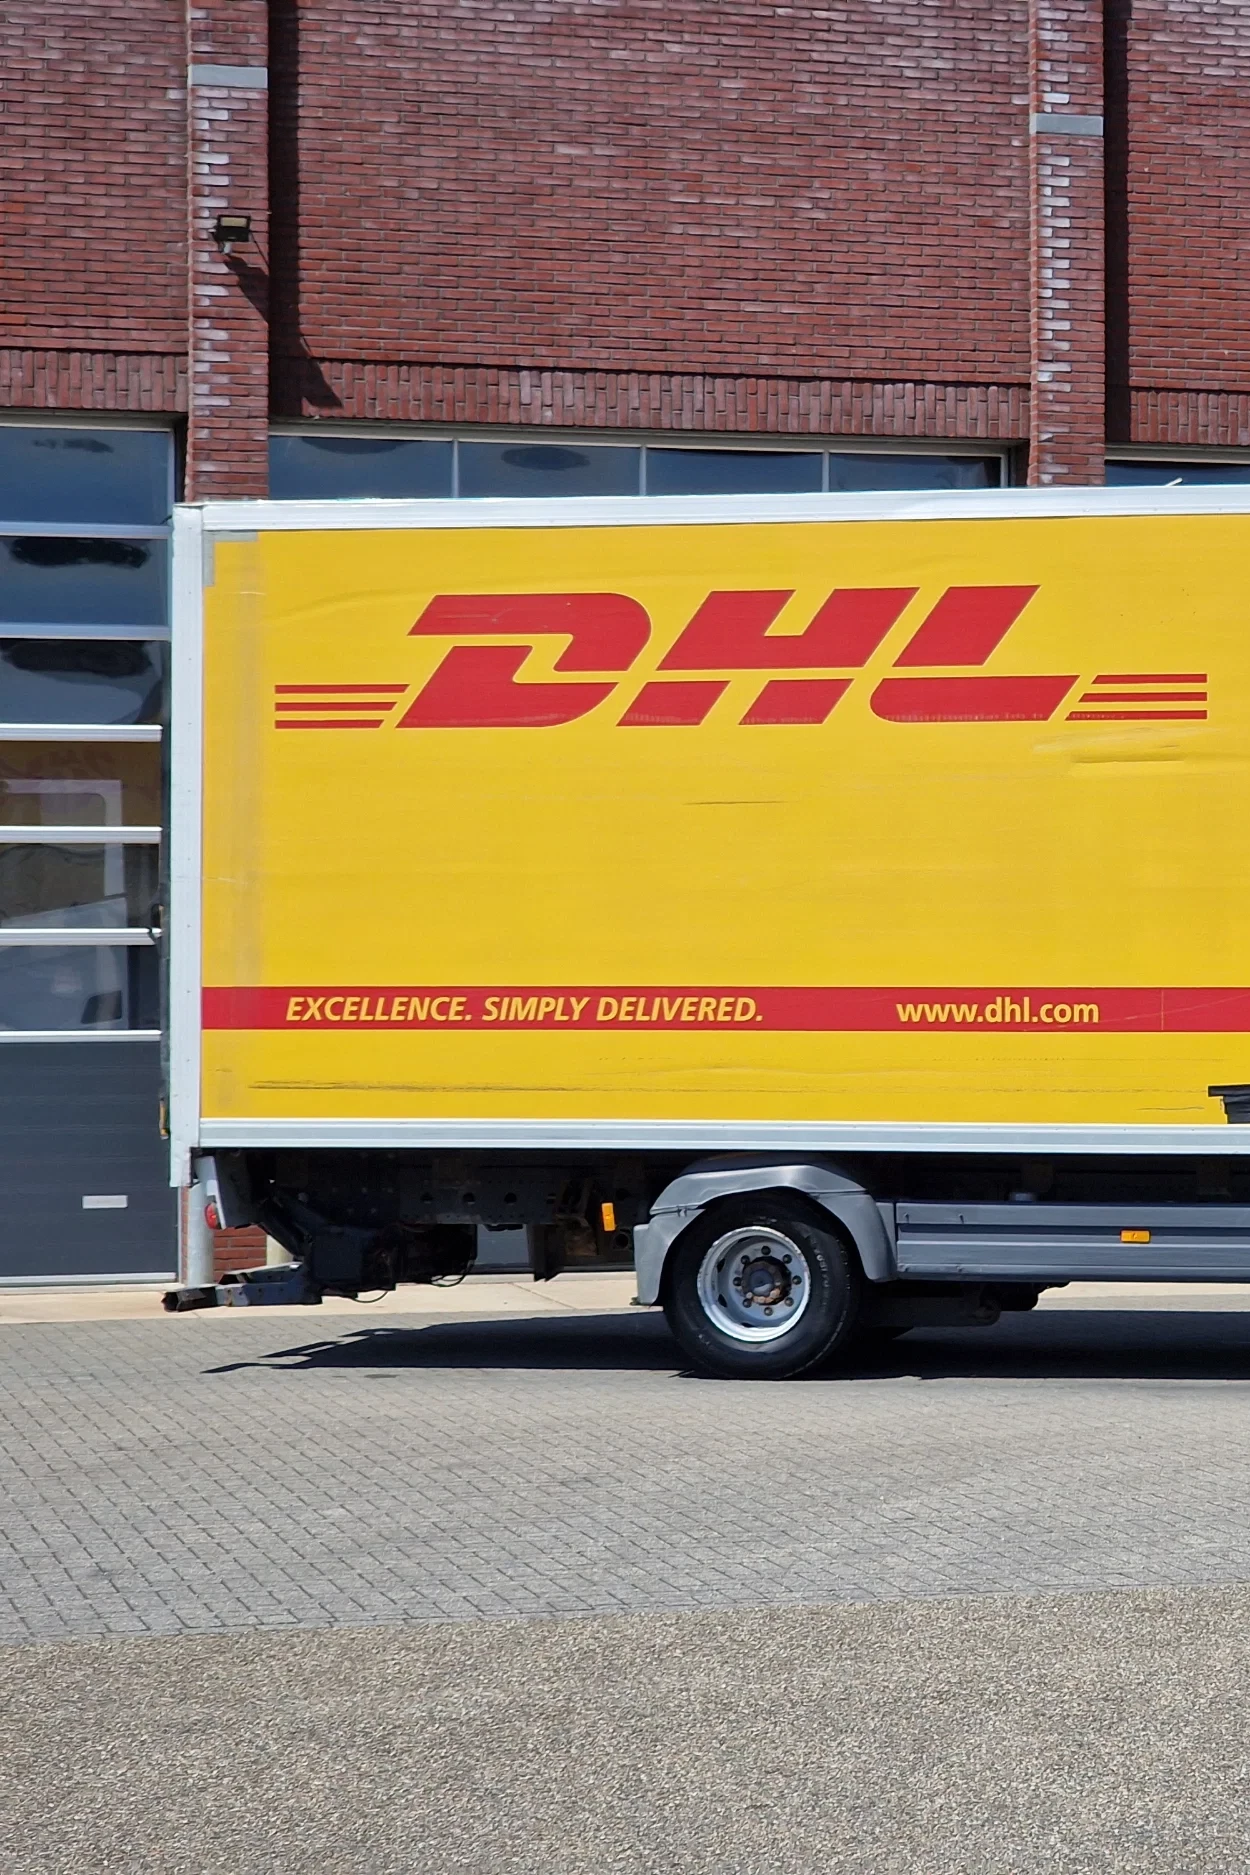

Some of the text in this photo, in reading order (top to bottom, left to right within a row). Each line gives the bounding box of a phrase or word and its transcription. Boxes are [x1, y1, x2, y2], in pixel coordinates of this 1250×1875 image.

[395, 584, 1079, 729] DHL
[286, 996, 763, 1022] EXCELLENCE. SIMPLY DELIVERED.
[895, 996, 1099, 1023] www.dhl.com
